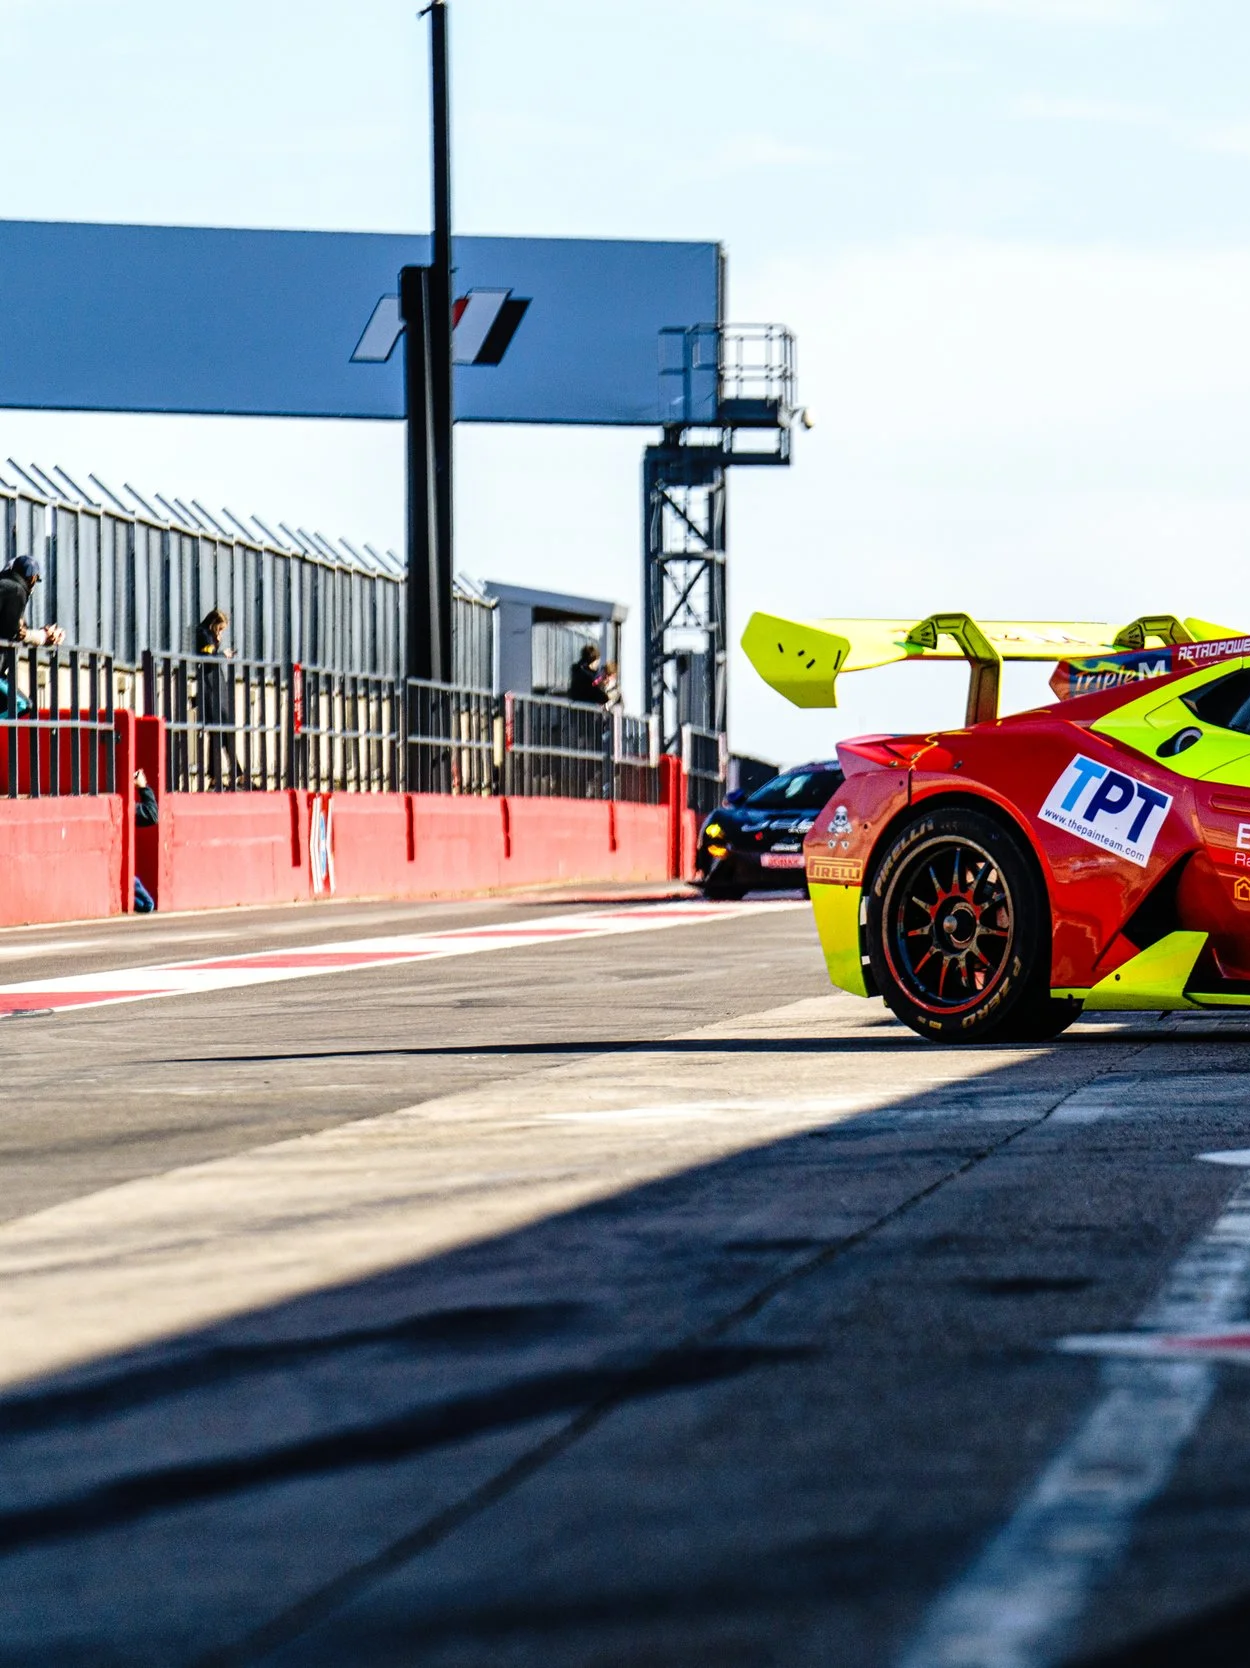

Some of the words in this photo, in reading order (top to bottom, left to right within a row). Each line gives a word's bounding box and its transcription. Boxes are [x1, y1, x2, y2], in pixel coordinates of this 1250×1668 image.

[1073, 757, 1169, 844] TPT
[1044, 808, 1145, 861] www.thepainteam.com
[807, 856, 863, 882] PIRELLI
